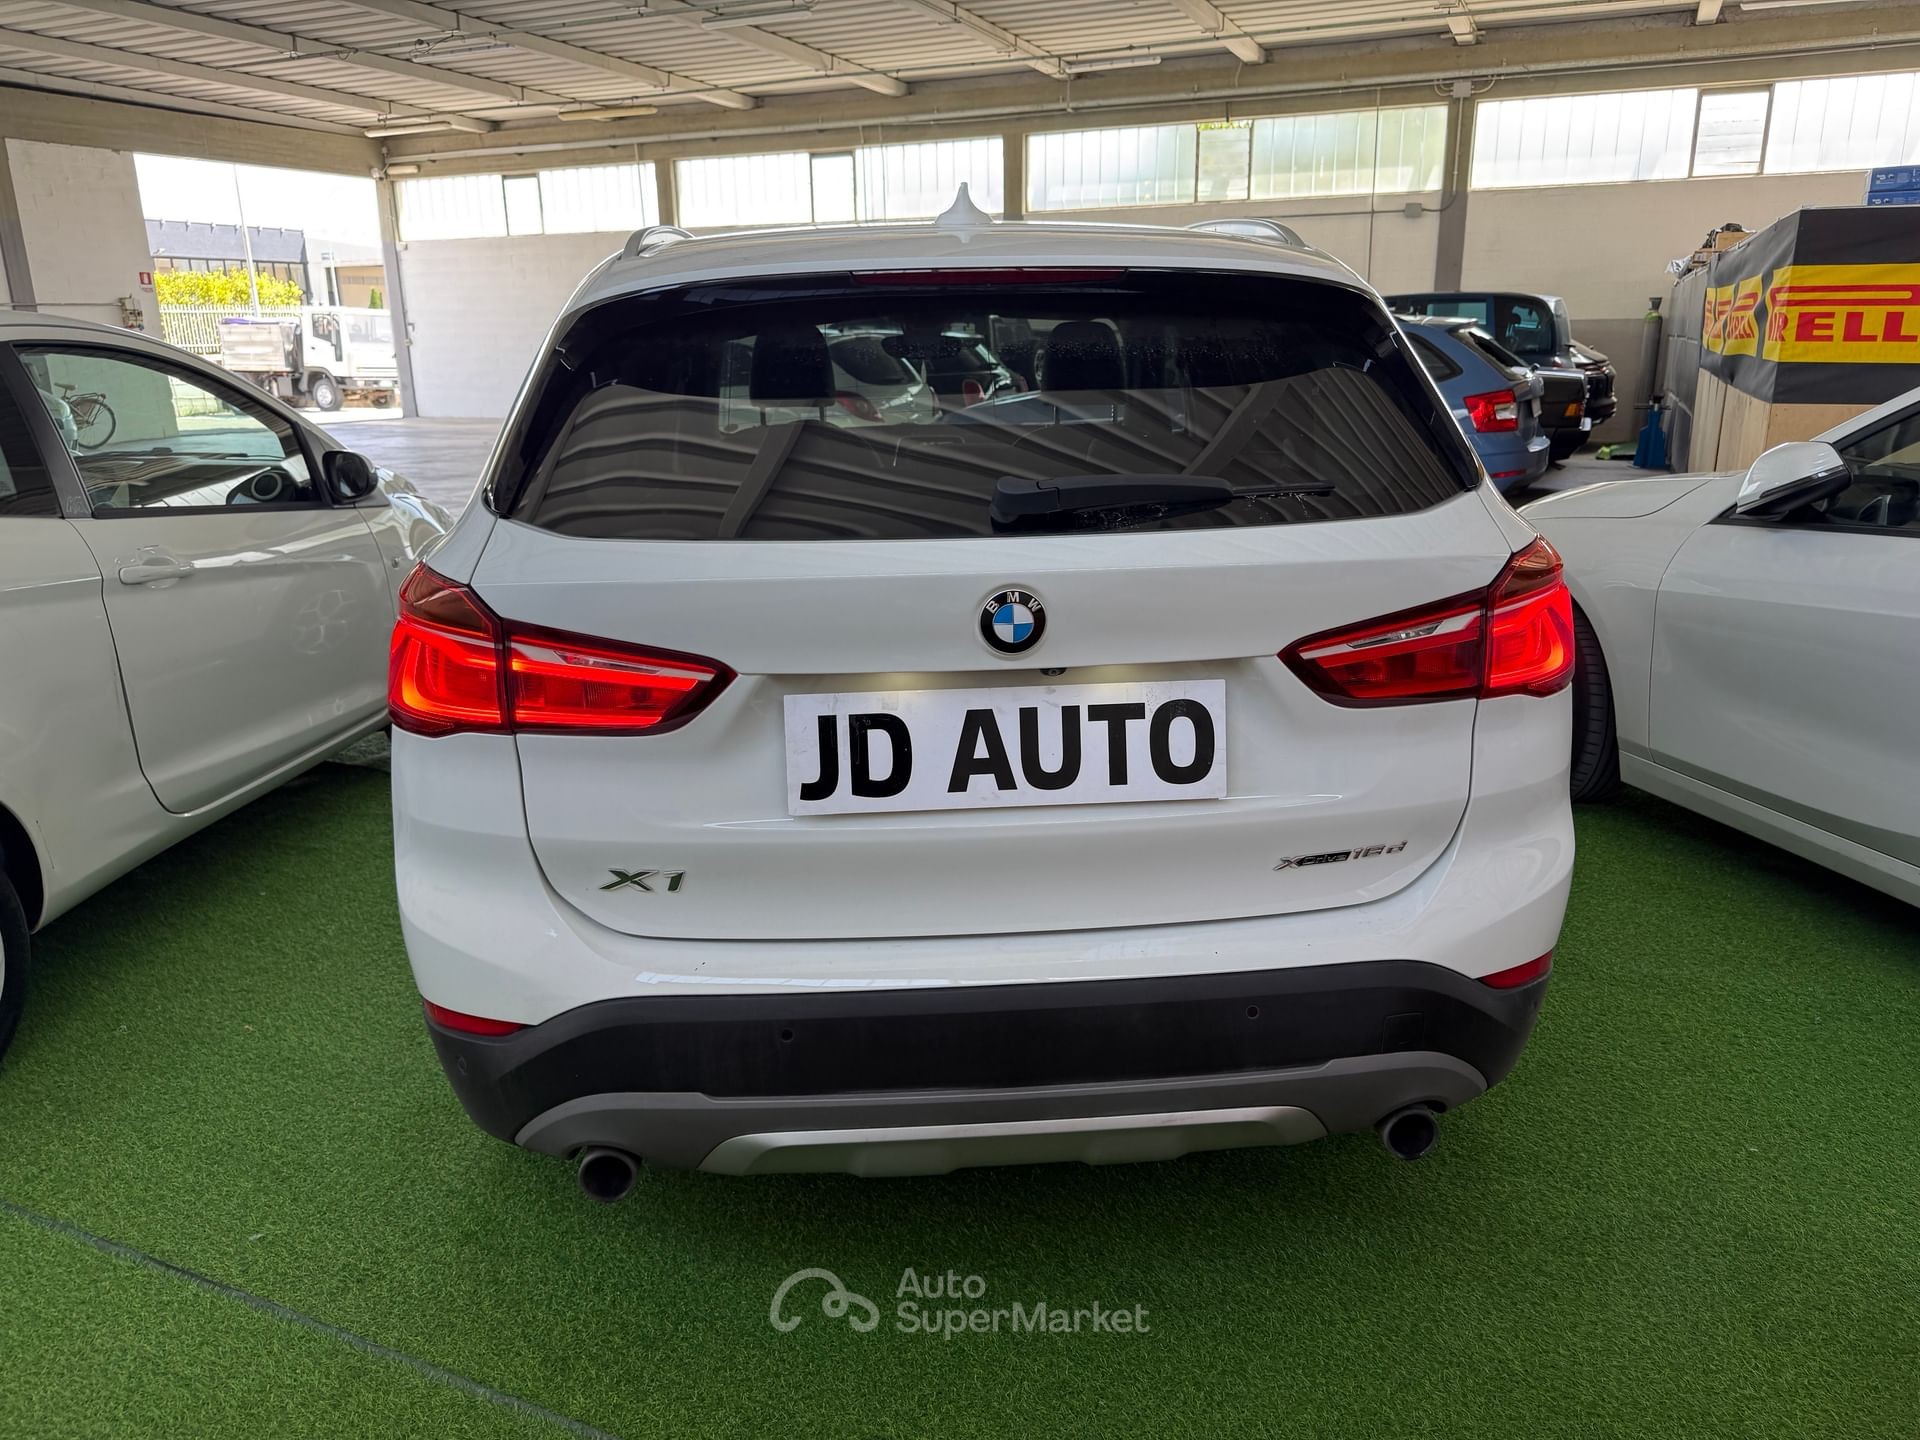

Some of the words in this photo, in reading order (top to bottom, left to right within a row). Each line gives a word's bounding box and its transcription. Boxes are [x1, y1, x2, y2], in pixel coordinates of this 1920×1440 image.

[985, 591, 1042, 614] BMW
[799, 713, 913, 801] JD
[947, 698, 1215, 793] AUTO
[599, 868, 686, 893] X1
